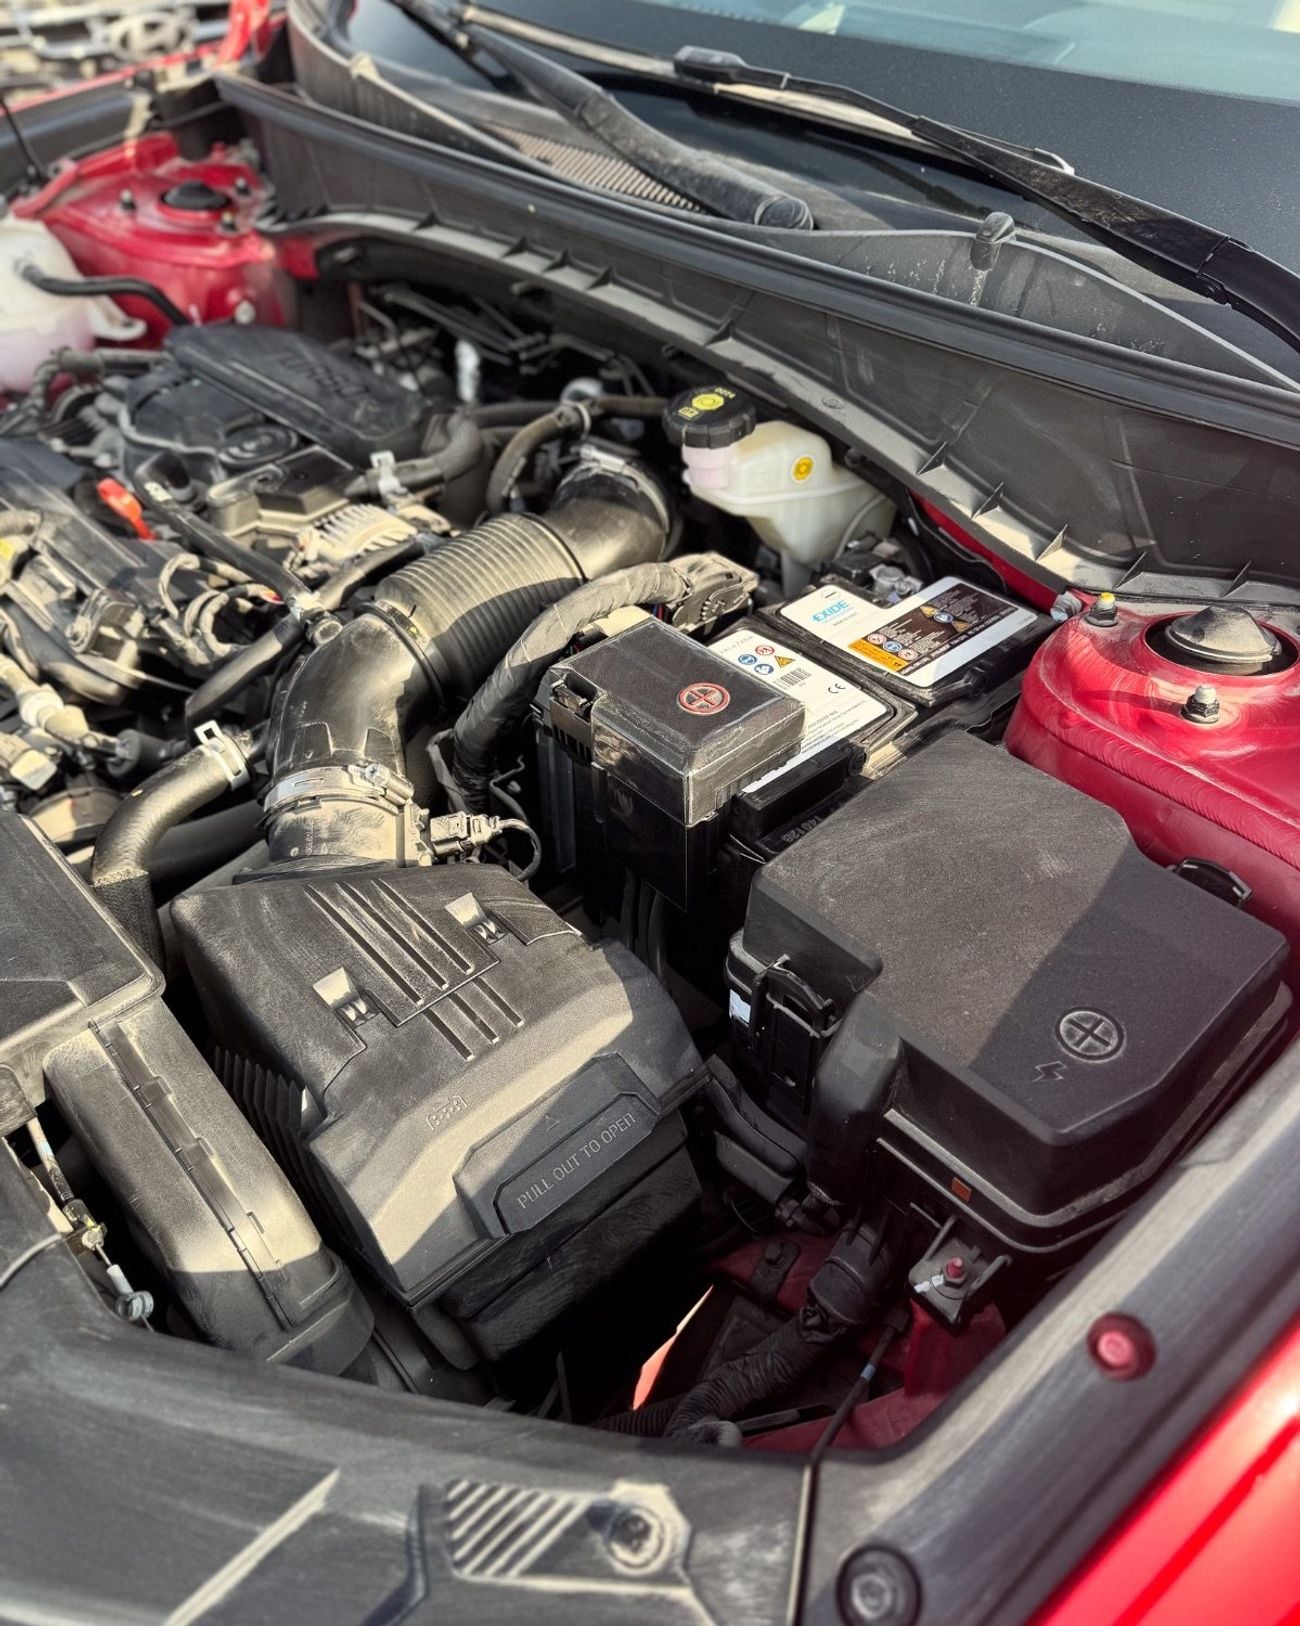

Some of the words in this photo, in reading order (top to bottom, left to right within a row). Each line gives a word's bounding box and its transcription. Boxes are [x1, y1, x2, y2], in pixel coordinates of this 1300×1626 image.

[812, 600, 849, 622] EXIDE
[828, 682, 846, 694] CE
[517, 1179, 554, 1209] PULL
[552, 1153, 580, 1181] OUT
[580, 1139, 601, 1158] TO
